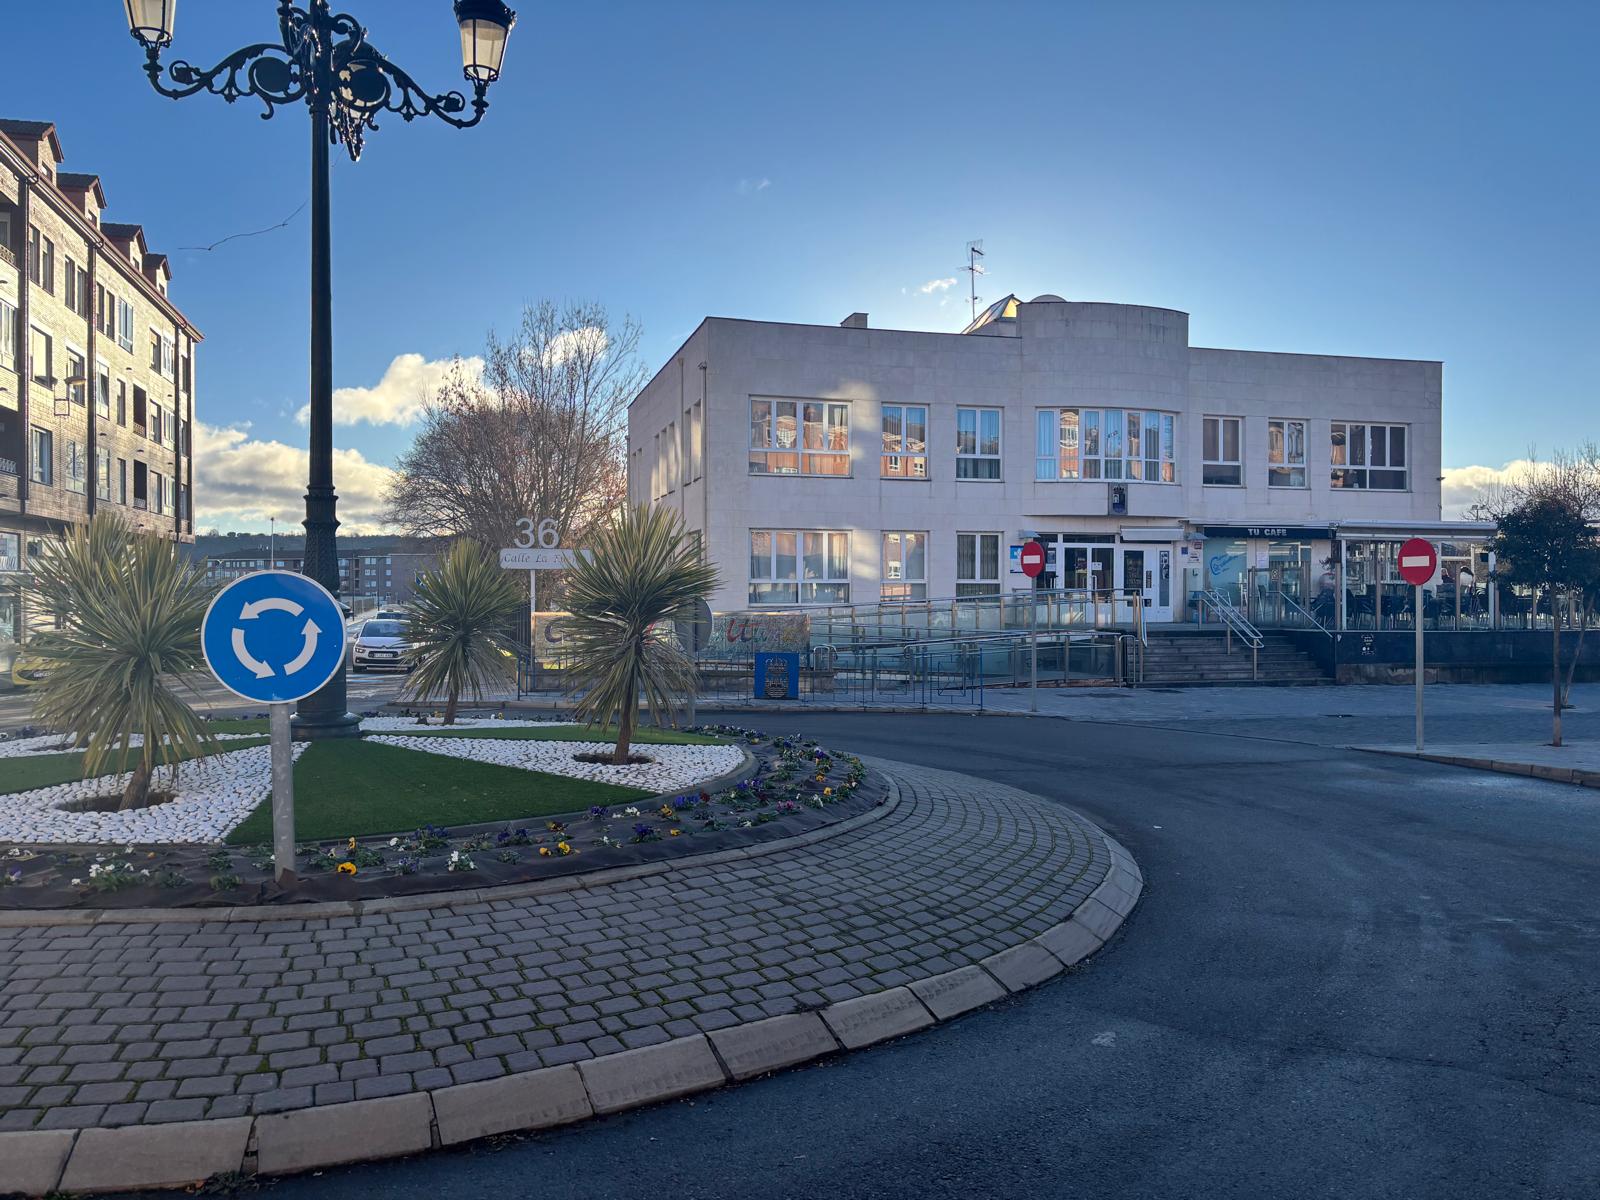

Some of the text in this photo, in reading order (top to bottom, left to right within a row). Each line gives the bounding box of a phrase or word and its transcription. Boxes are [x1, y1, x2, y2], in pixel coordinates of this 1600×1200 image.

[513, 517, 560, 549] 36
[1247, 528, 1260, 536] TU
[504, 552, 530, 563] Calle
[536, 553, 547, 563] La
